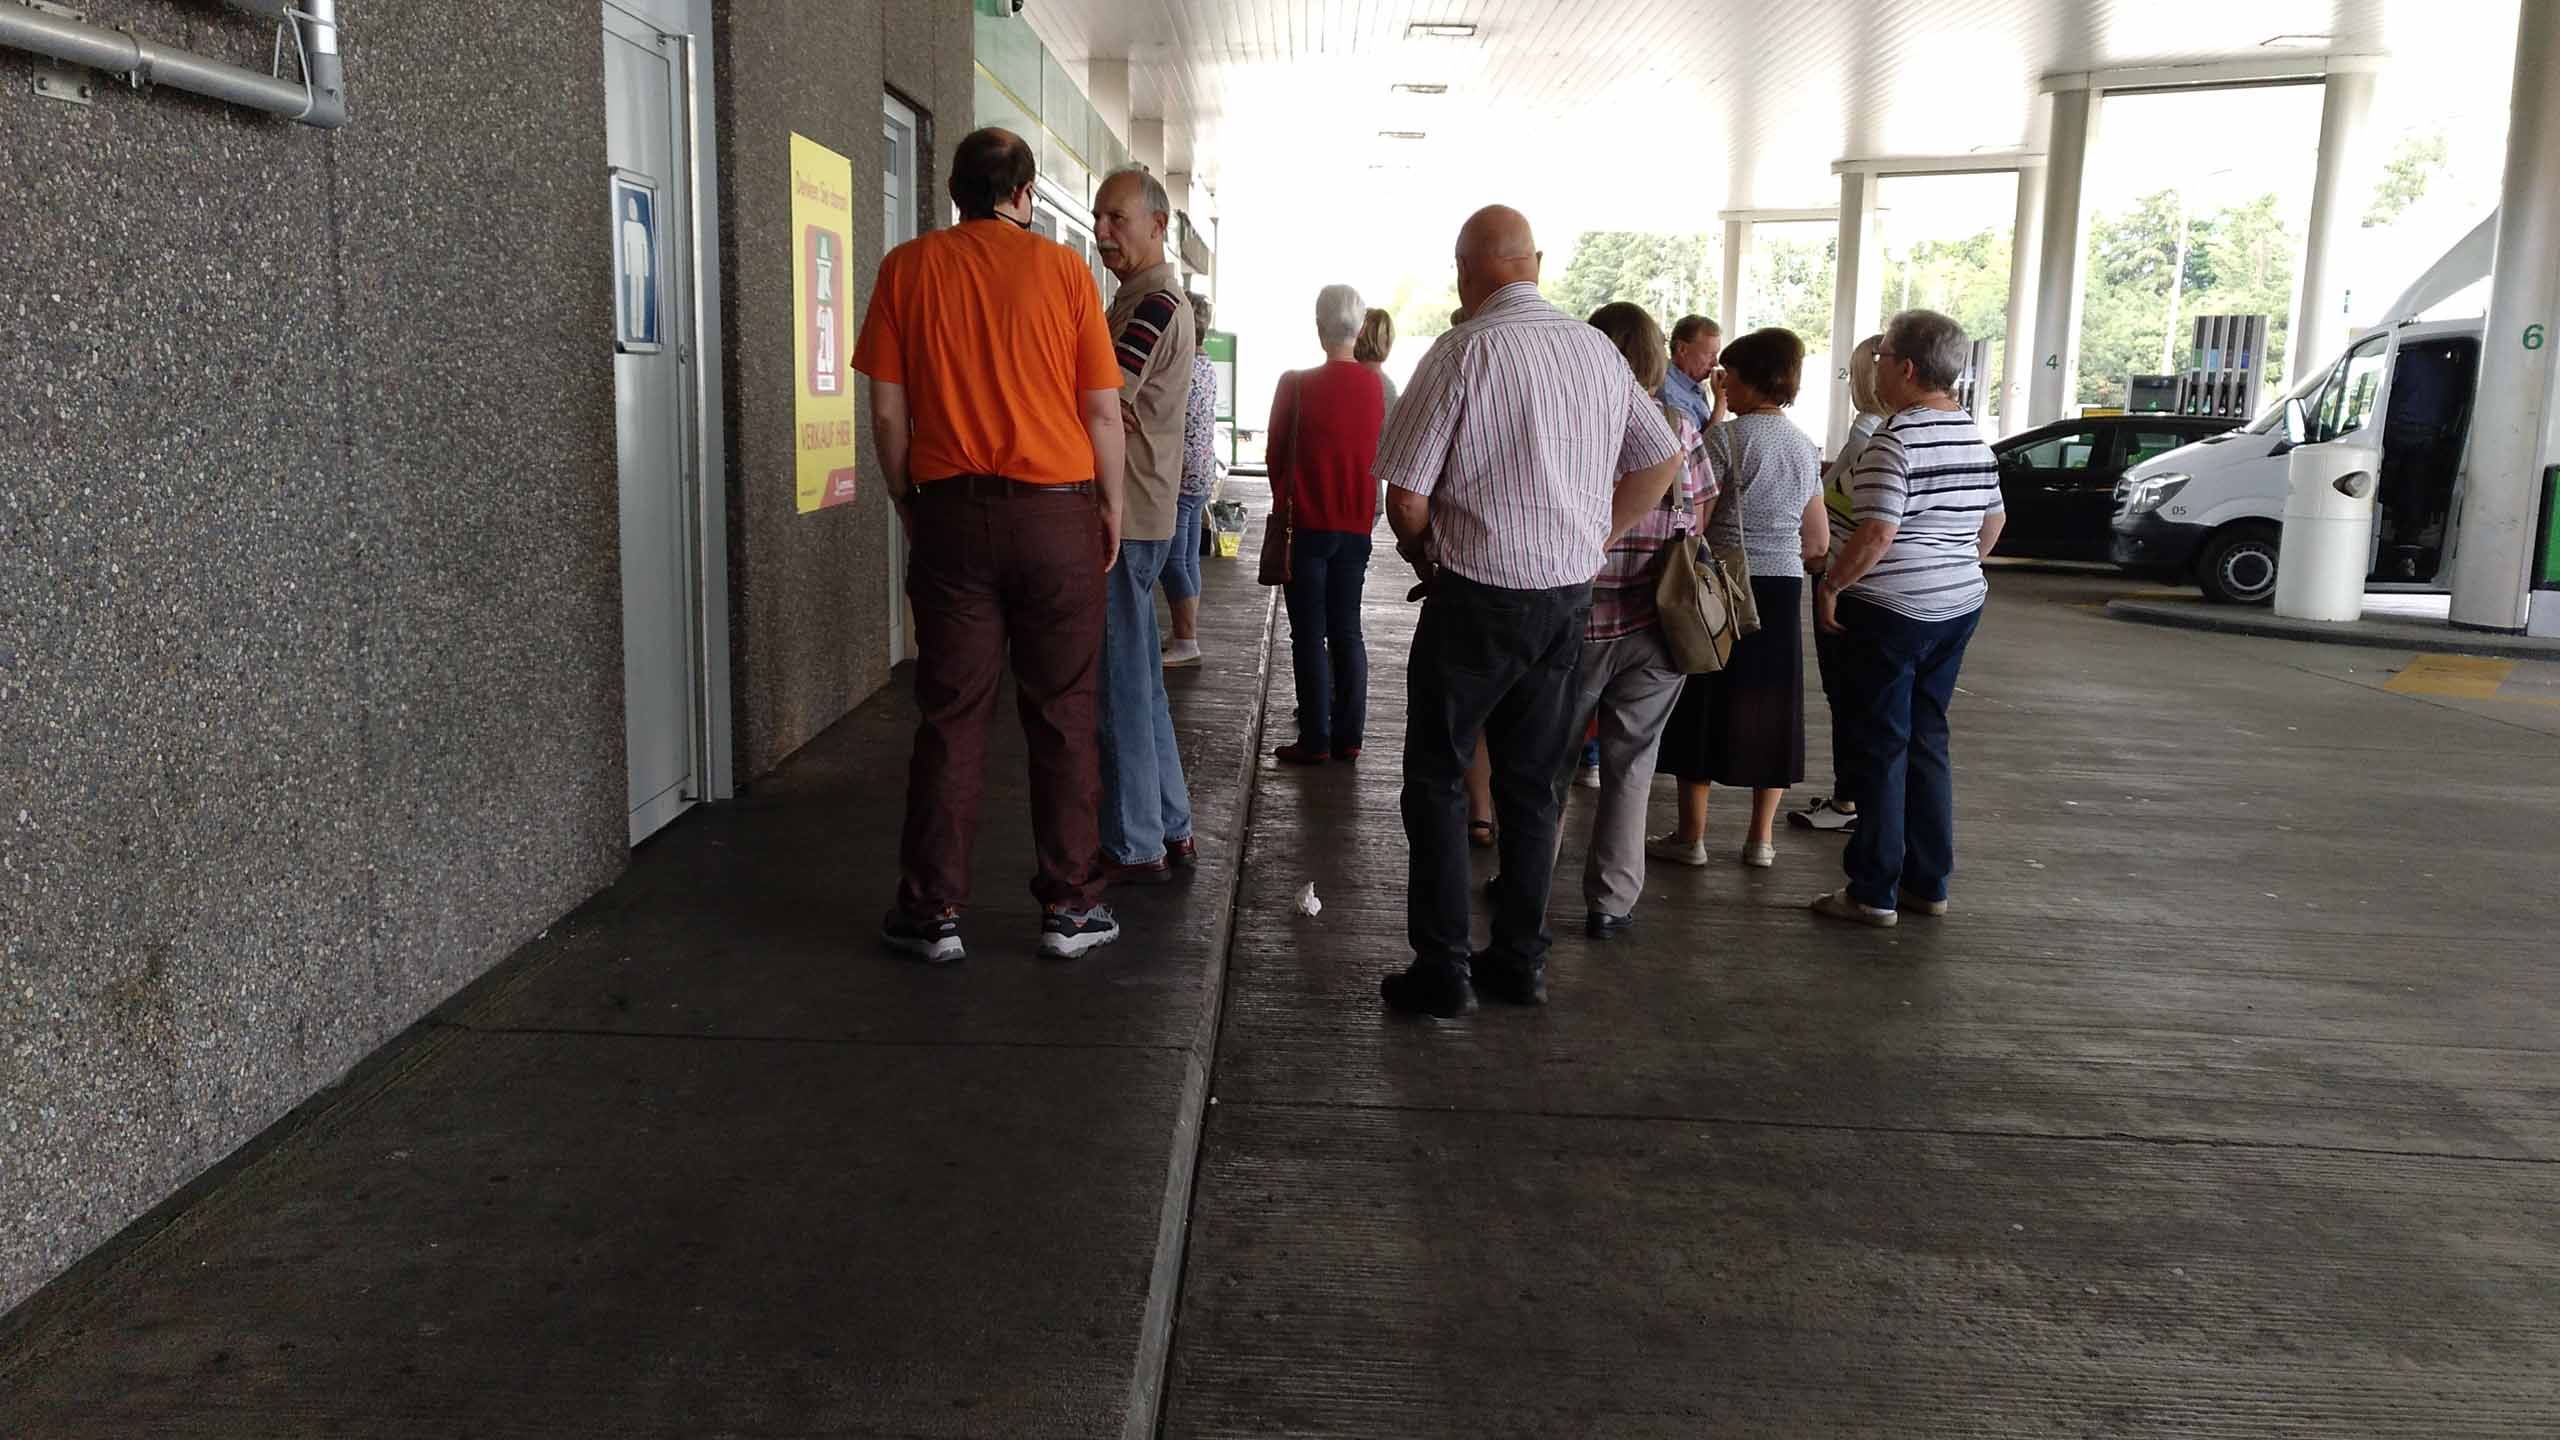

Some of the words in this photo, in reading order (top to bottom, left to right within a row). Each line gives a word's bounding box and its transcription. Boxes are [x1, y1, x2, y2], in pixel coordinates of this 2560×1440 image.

[2522, 323, 2545, 350] 6
[2046, 354, 2060, 370] 4
[1838, 367, 1847, 380] 2
[2172, 505, 2187, 515] 05
